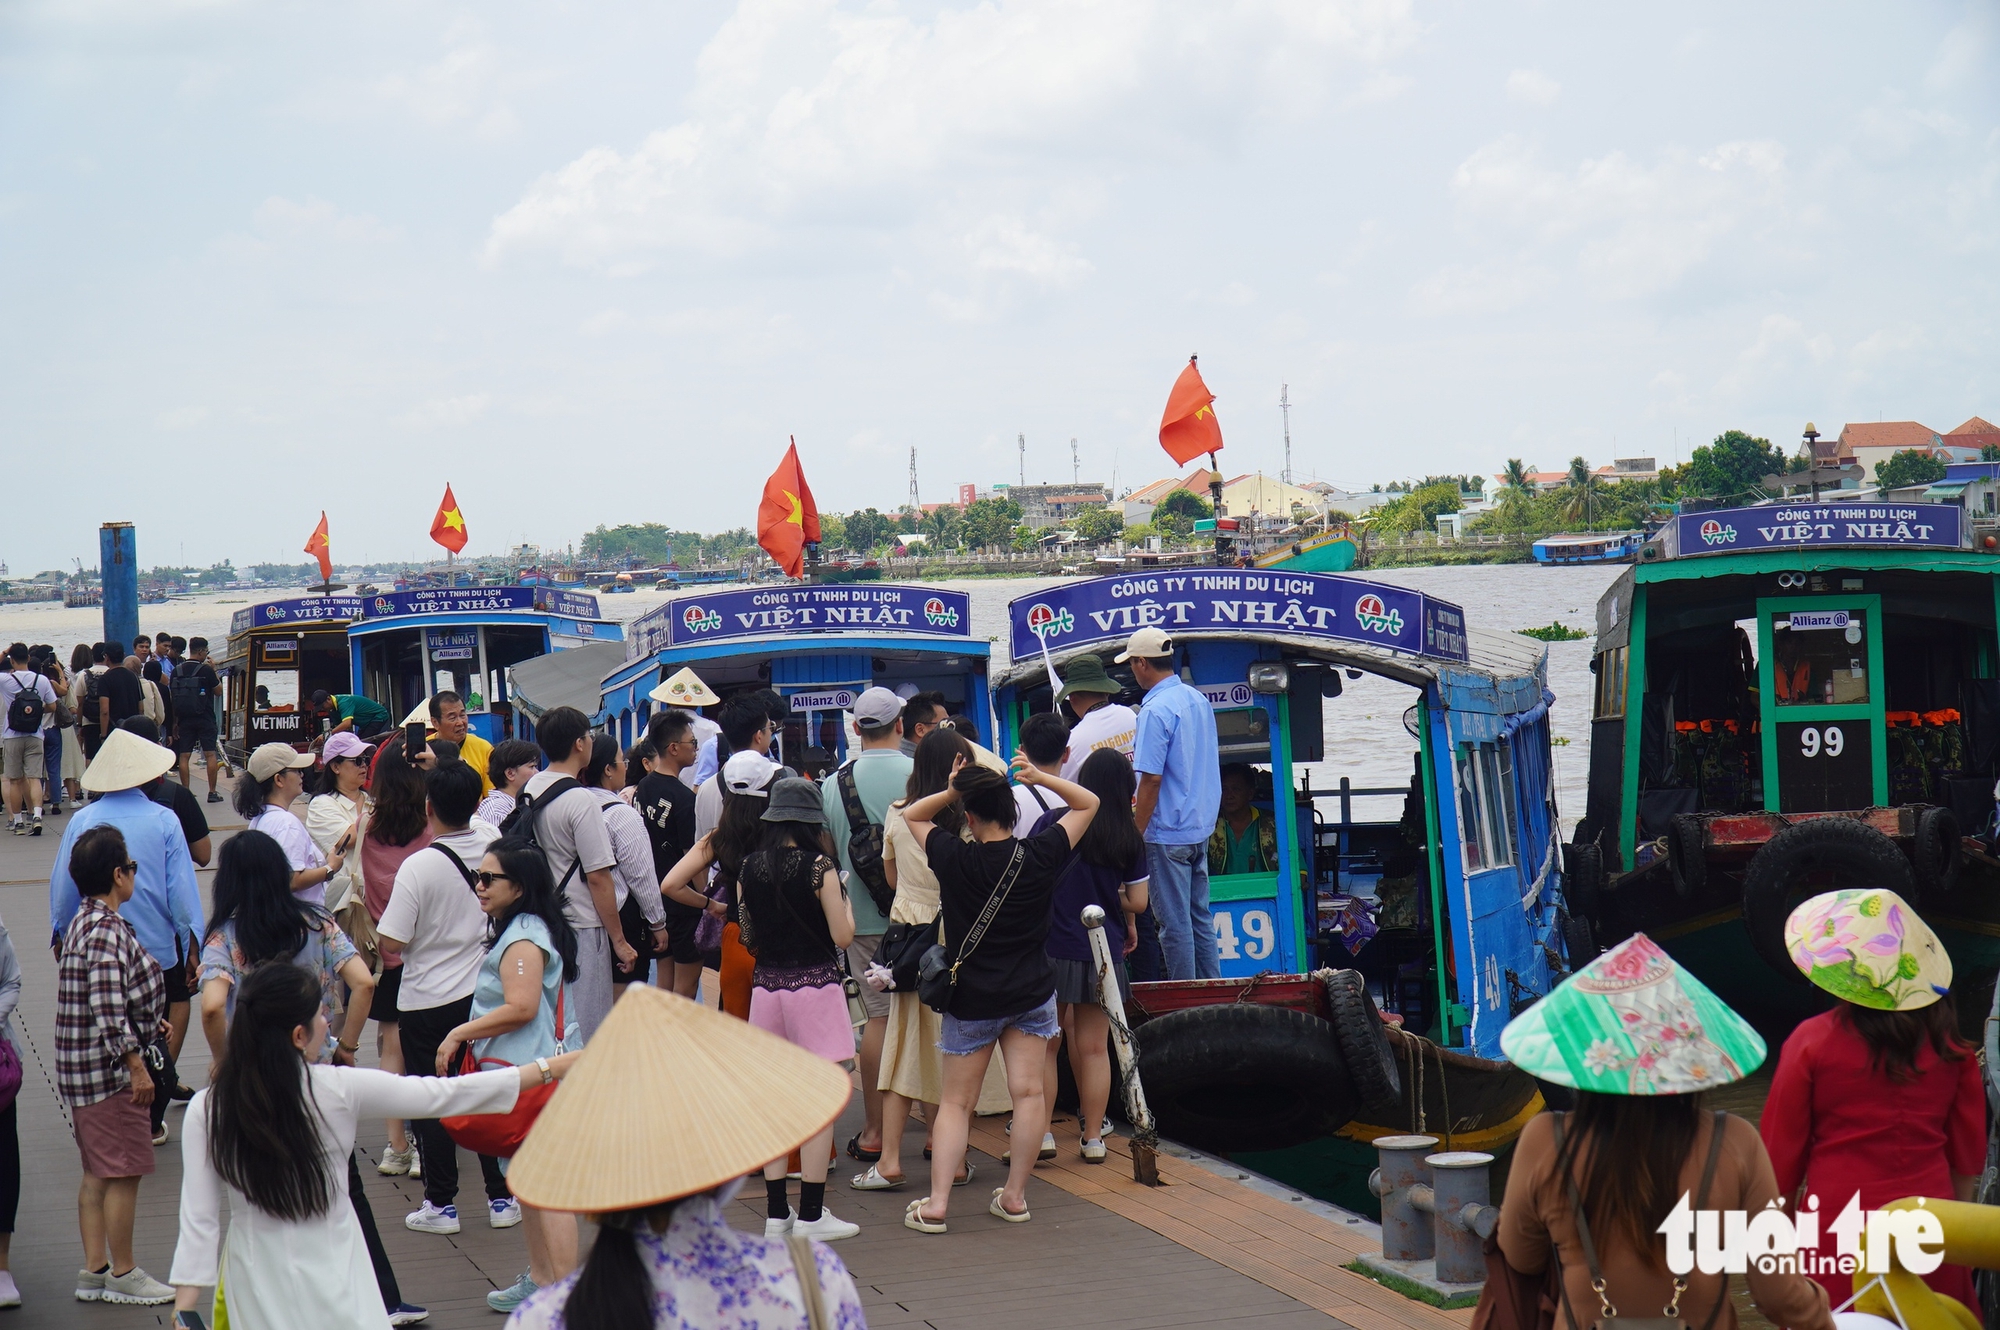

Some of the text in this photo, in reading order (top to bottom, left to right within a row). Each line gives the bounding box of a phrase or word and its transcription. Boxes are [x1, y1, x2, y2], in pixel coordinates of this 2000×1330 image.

[1776, 508, 1916, 521] CÔNG TY TNHH DU LỊCH
[1758, 521, 1934, 543] VIỆT NHẬT
[416, 591, 436, 600] CÔNG
[449, 590, 470, 598] TNHH
[471, 589, 482, 597] DU
[483, 589, 502, 598] LỊCH
[1111, 576, 1314, 598] CÔNG TY TNHH DU LỊCH
[301, 598, 320, 607] CÔNG
[407, 597, 513, 613] VIỆT NHẬT
[753, 591, 901, 606] CÔNG TY TNHH DU LỊCH
[293, 606, 335, 618] VIỆT
[735, 604, 914, 629] VIỆT NHẬT
[1211, 598, 1337, 630] NHẬT
[1792, 615, 1832, 626] Allianz
[266, 641, 288, 649] Allianz
[452, 633, 475, 646] NHẬT
[438, 649, 461, 658] Allianz
[792, 696, 833, 707] Allianz
[1801, 727, 1844, 758] 99
[968, 895, 1000, 943] LOUIS VUITTON
[1212, 910, 1275, 960] 49
[1485, 953, 1501, 1011] 49
